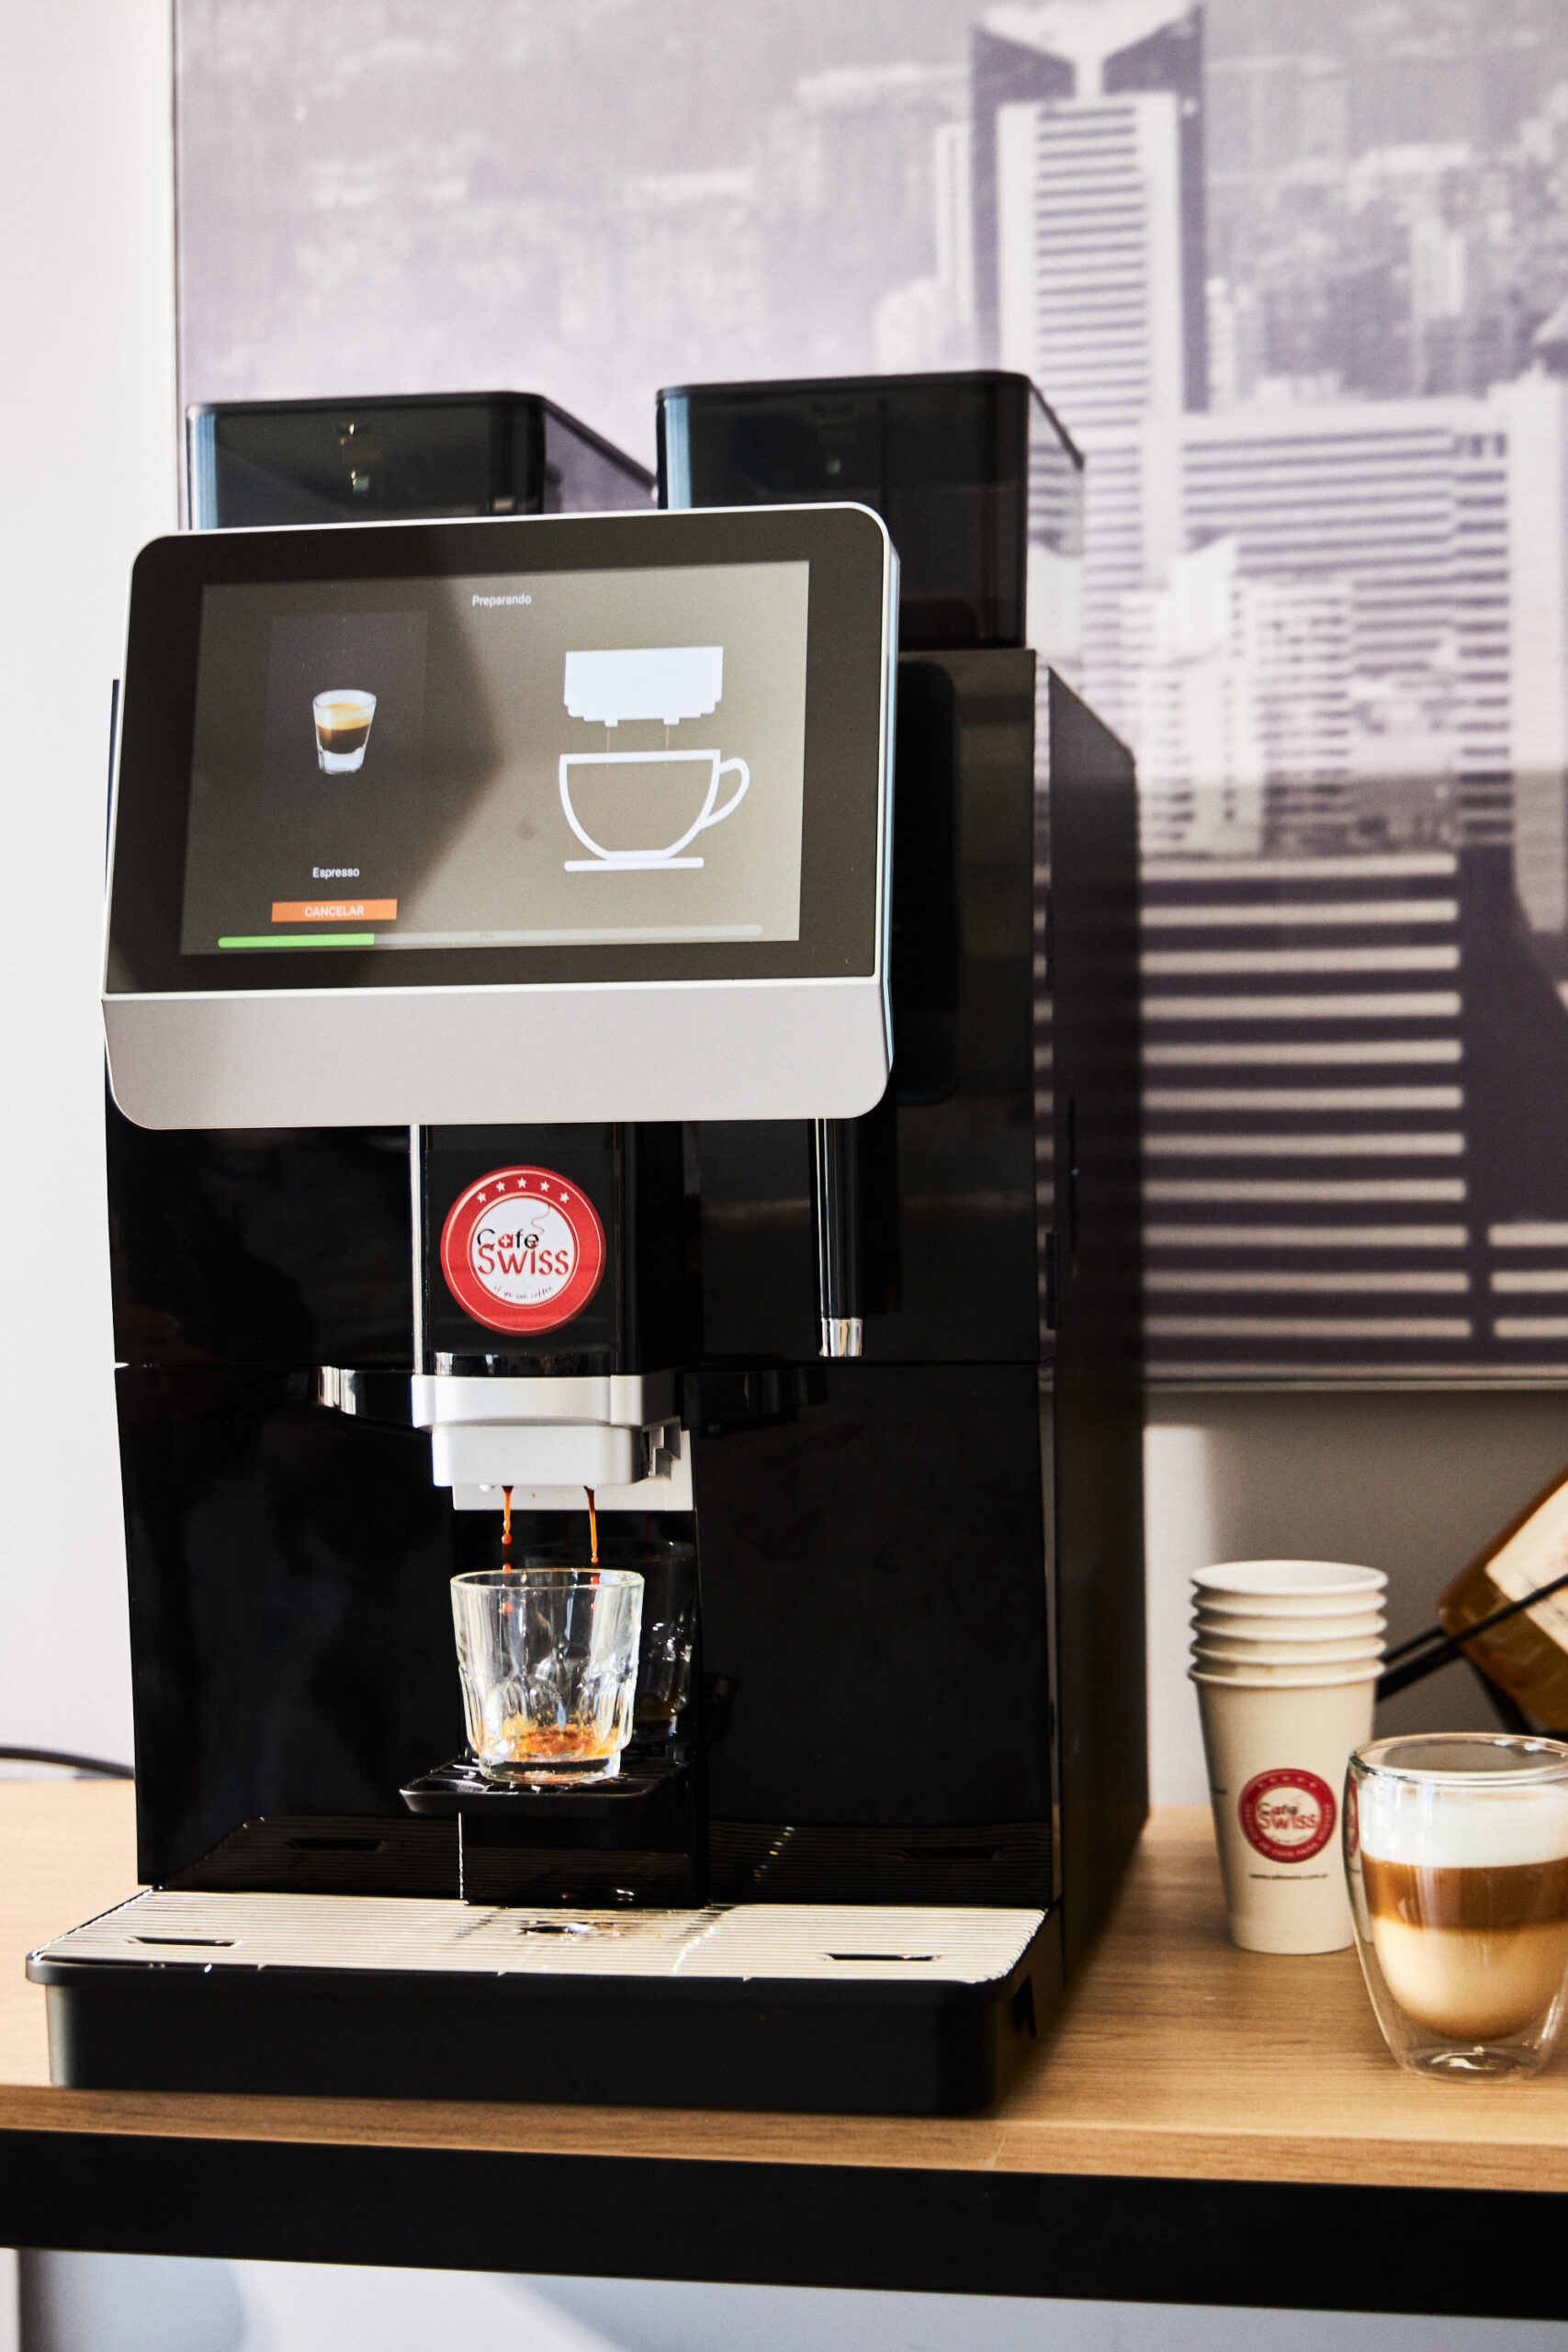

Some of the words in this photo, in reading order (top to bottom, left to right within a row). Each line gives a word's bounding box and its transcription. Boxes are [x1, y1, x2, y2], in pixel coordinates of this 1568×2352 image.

[472, 593, 532, 608] Preparando
[312, 866, 360, 880] Espresso
[304, 905, 365, 918] CANCELAR
